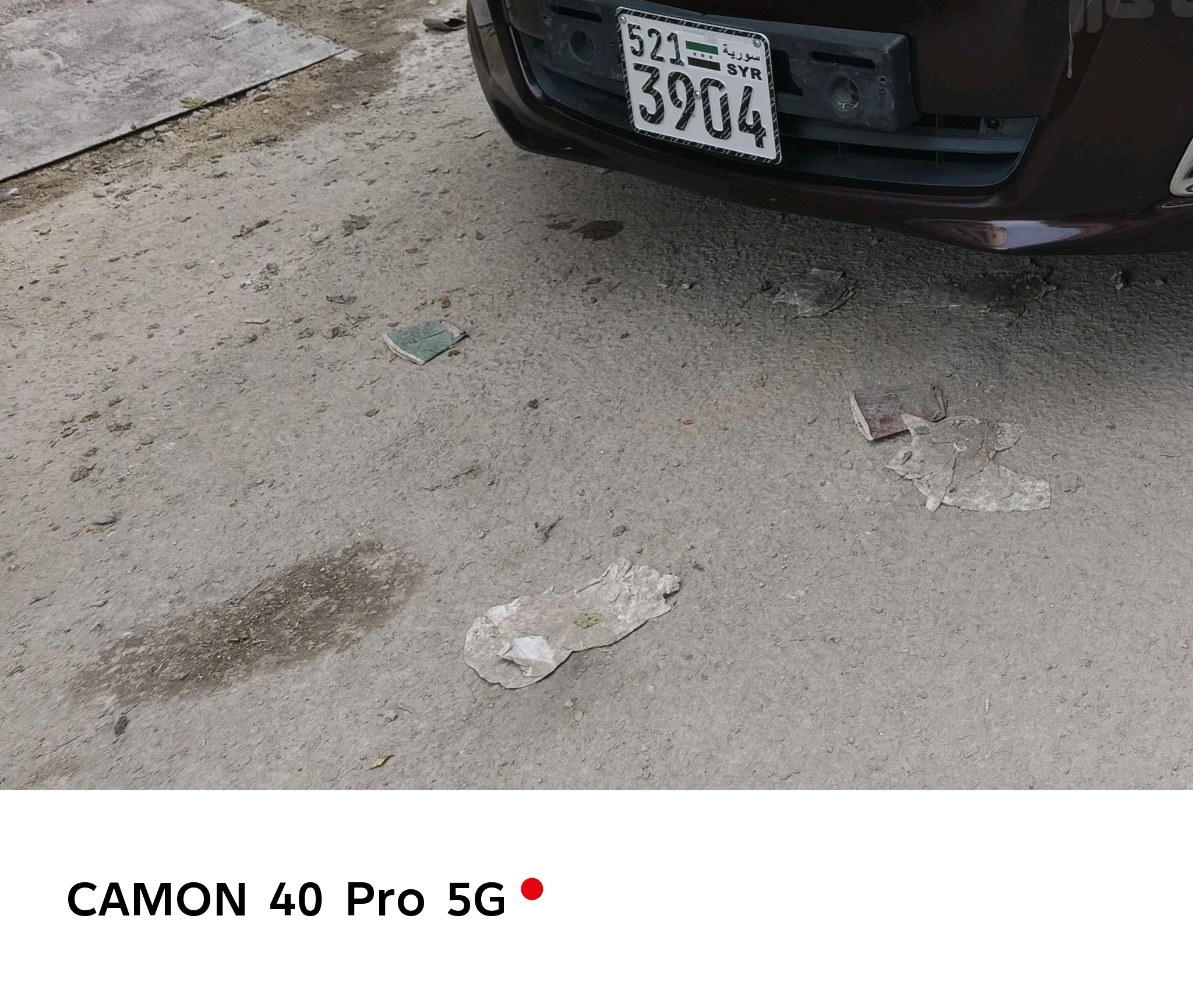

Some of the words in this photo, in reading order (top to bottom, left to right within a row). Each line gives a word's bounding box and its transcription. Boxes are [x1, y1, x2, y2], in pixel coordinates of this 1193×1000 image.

[627, 23, 685, 67] 521
[722, 43, 761, 63] سورية
[726, 63, 763, 81] SYR
[633, 62, 767, 149] 3904
